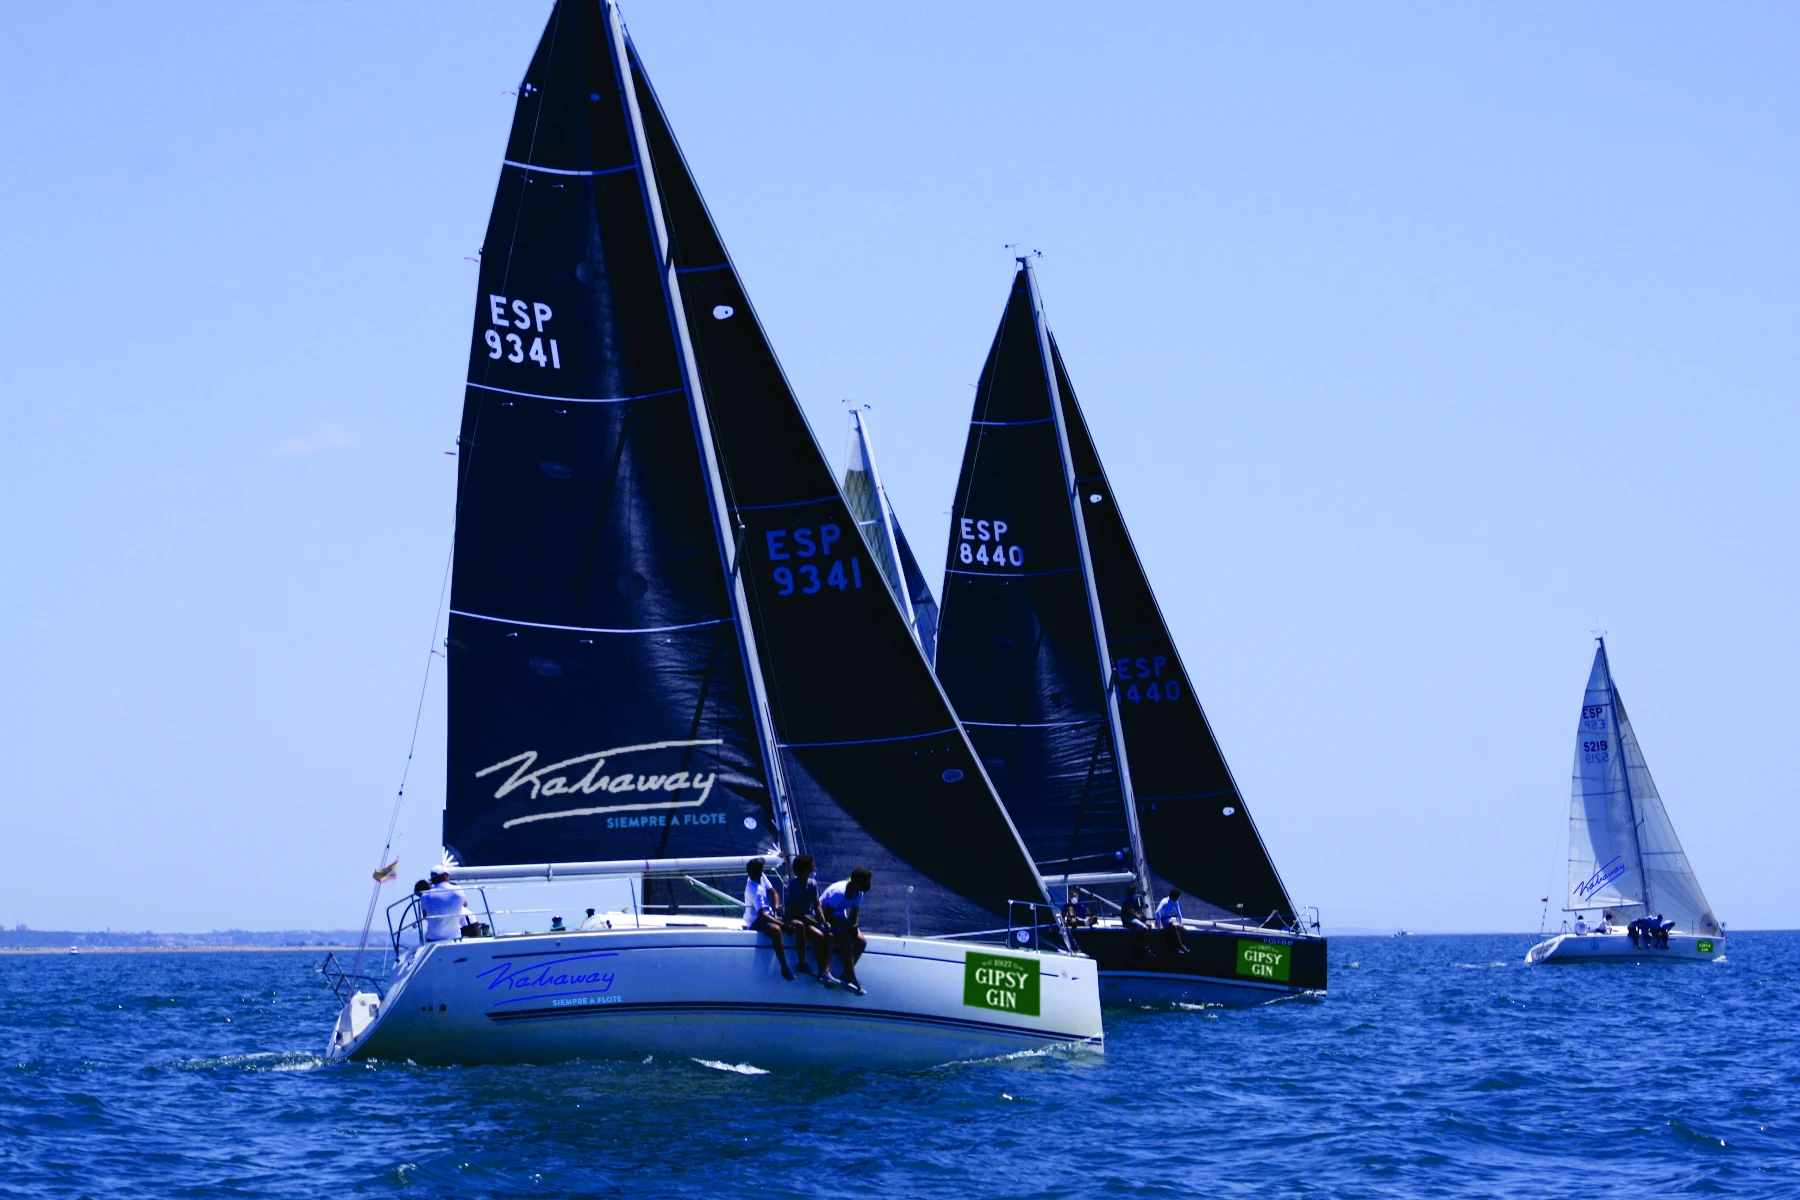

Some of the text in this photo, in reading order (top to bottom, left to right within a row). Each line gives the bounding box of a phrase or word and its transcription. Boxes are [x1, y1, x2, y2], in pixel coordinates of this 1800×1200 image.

[489, 294, 553, 333] ESP
[484, 329, 561, 369] 9341
[960, 517, 1008, 542] ESP
[766, 523, 841, 561] ESP
[960, 542, 1025, 567] 8440
[773, 556, 862, 597] 9341
[1116, 655, 1167, 680] ESP
[1582, 707, 1603, 719] ESP
[1583, 740, 1608, 752] 5219
[606, 813, 727, 829] SIEMPRE A FLOTE
[994, 959, 1012, 969] 1927
[1244, 950, 1283, 965] GIPSY
[975, 967, 1028, 990] GIPSY
[1251, 963, 1273, 977] GIN
[552, 997, 588, 1006] SIEMPRE
[597, 995, 622, 1004] FLOTE
[986, 988, 1017, 1009] GIN
